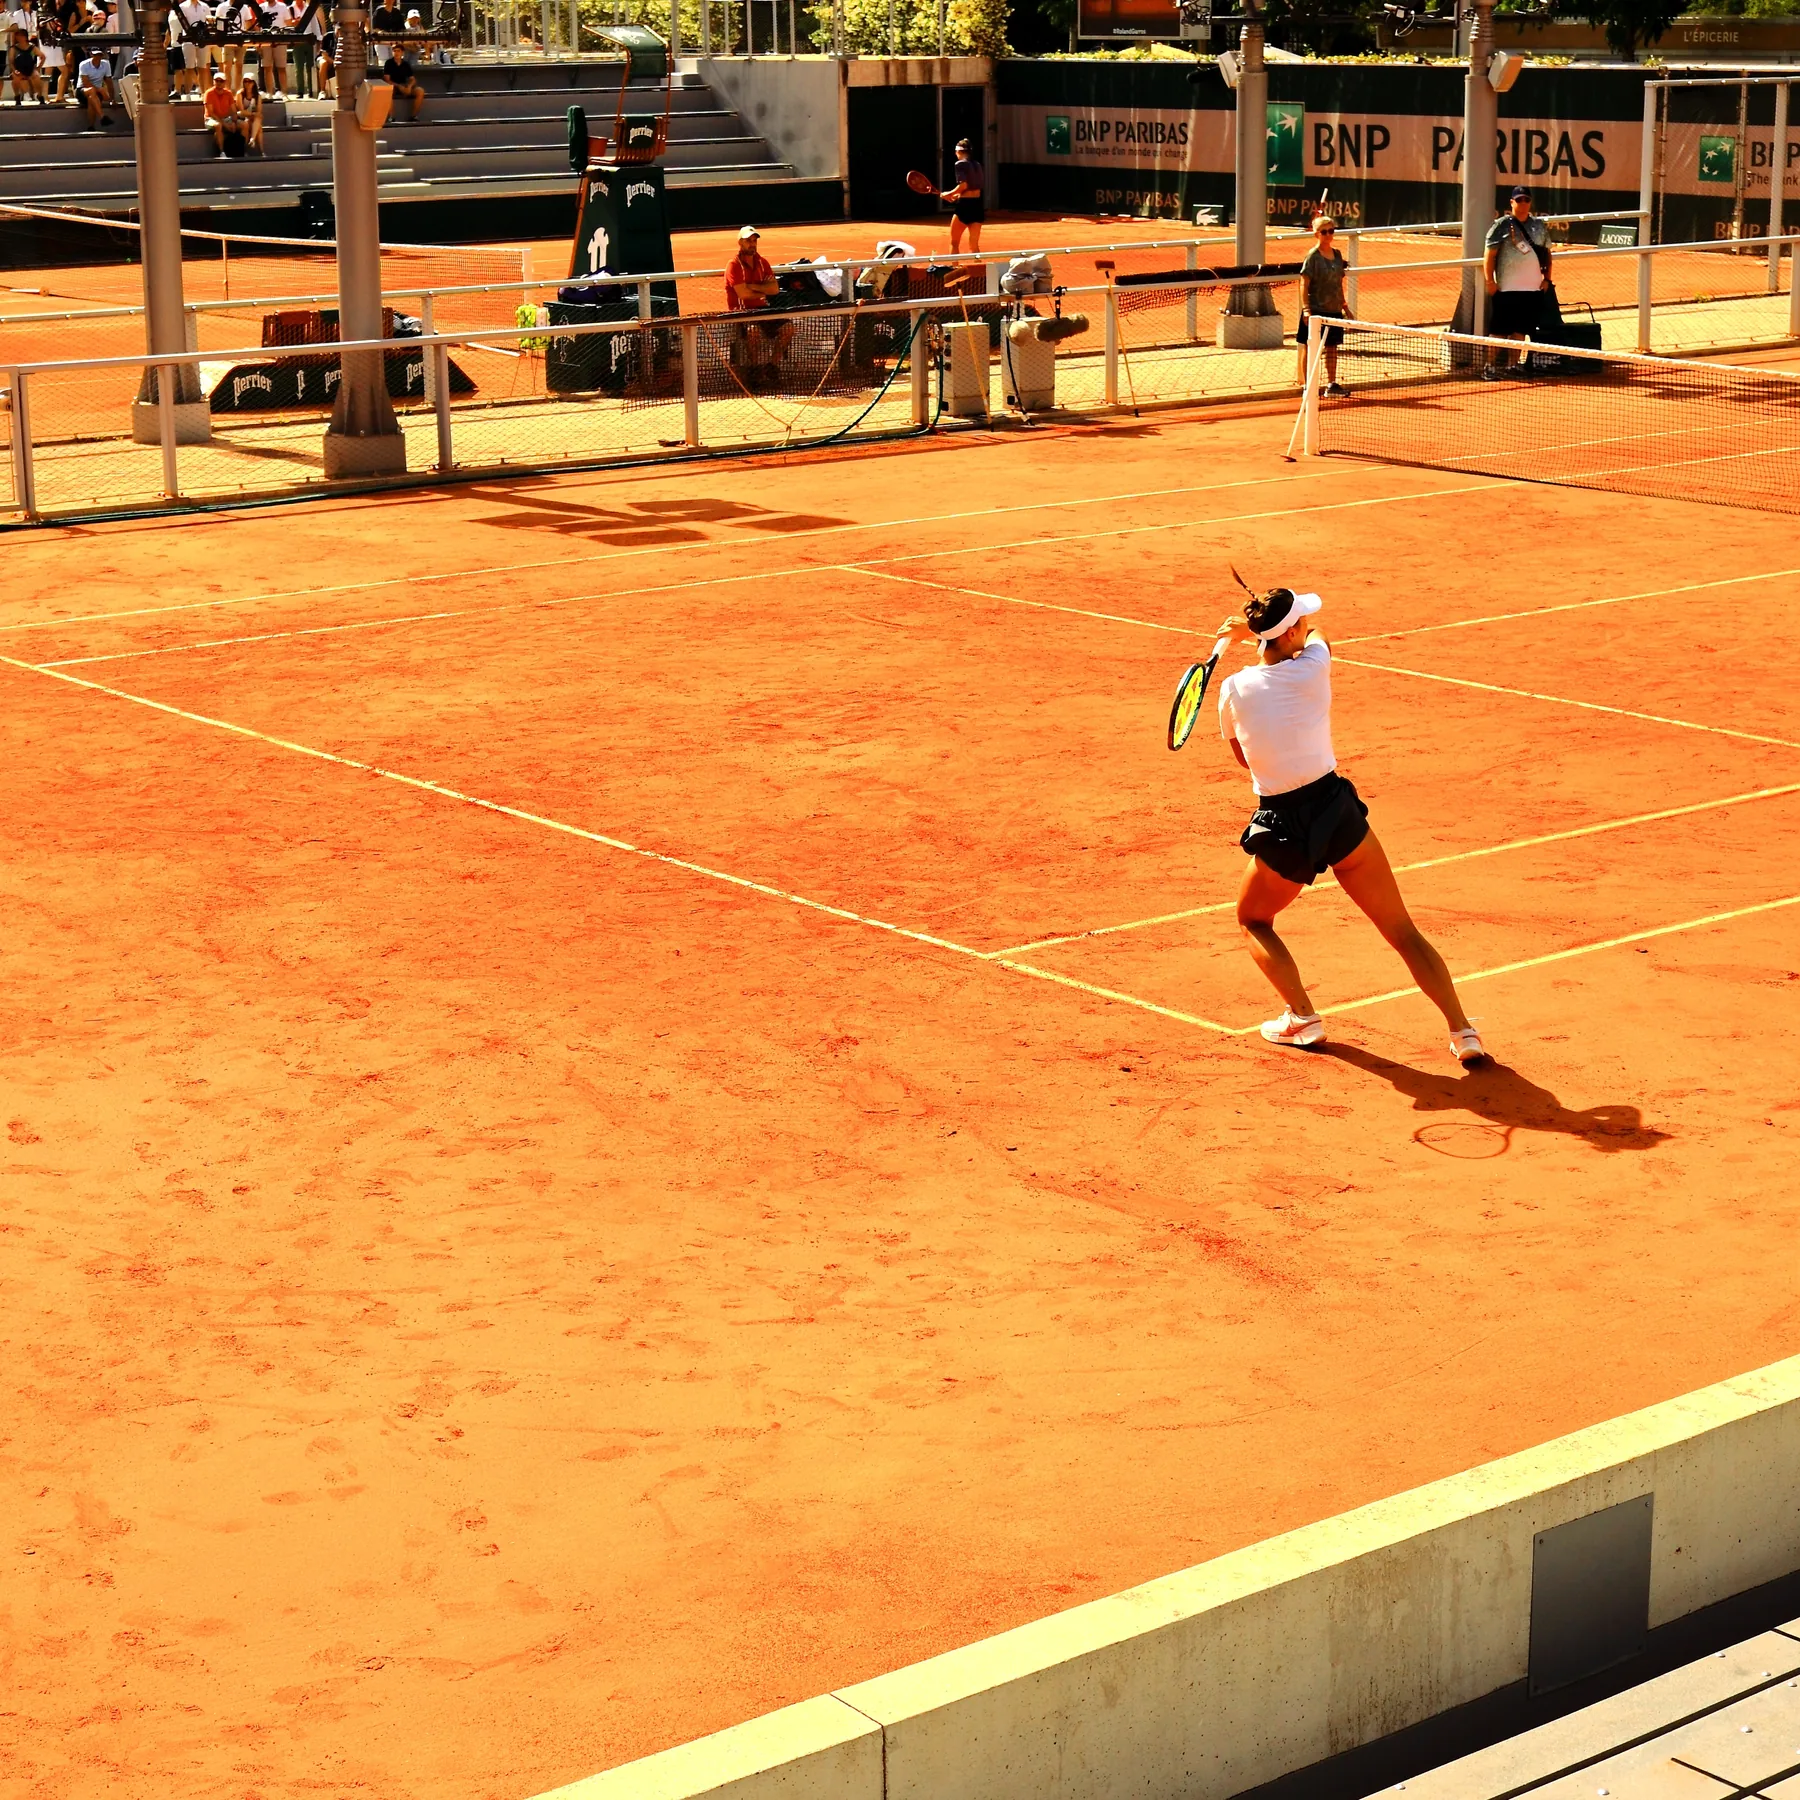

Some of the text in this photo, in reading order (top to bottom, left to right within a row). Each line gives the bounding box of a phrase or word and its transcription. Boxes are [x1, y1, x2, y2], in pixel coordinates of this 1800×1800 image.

[1683, 28, 1739, 43] L'ÉPICERIE
[1075, 120, 1189, 145] BNP PARIBAS
[1314, 122, 1391, 168] BNP
[1096, 189, 1180, 209] BNP PARIBAS
[1266, 198, 1360, 219] BNP PARIBAS
[1601, 233, 1633, 245] LACOSTE
